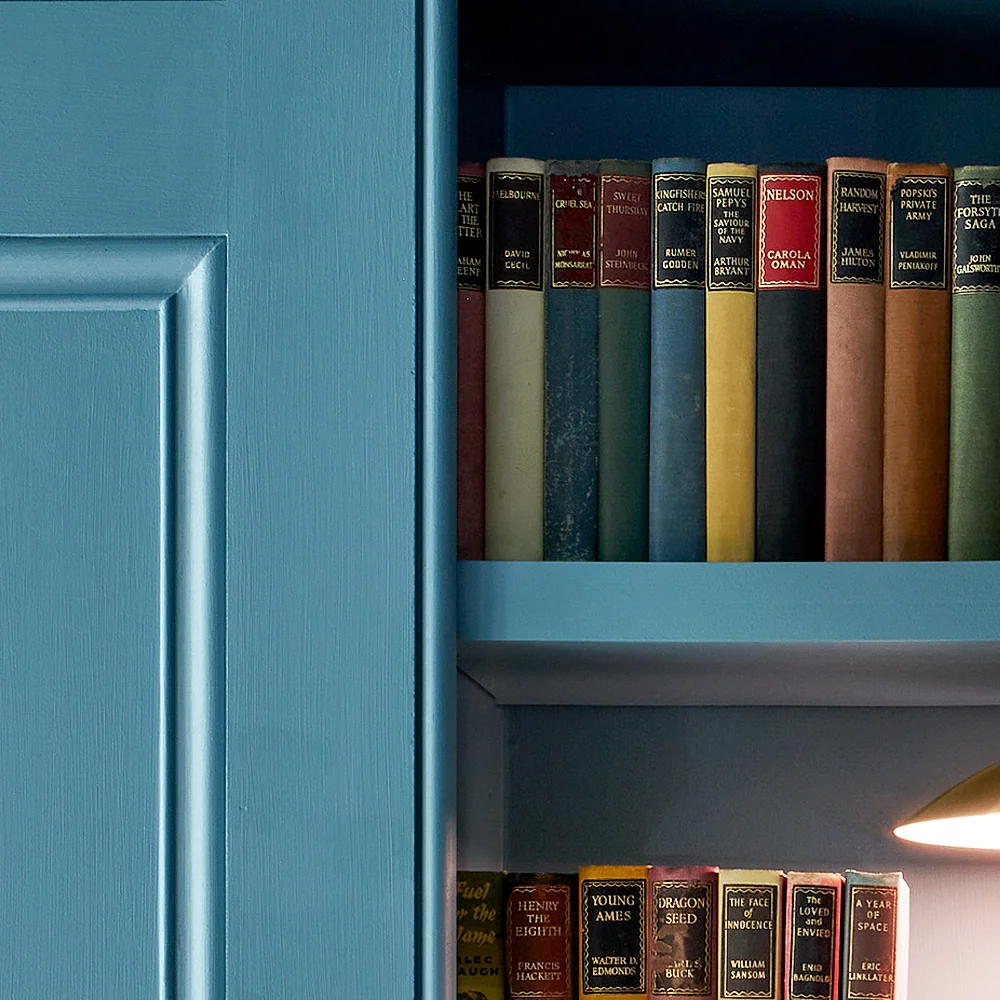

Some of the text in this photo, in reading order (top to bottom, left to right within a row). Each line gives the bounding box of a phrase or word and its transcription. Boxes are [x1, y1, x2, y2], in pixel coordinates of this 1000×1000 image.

[712, 188, 751, 198] SAMUEL
[767, 189, 814, 200] NELSON
[841, 188, 879, 199] RANDOM
[970, 195, 991, 204] THE
[900, 200, 936, 210] PRIVATE
[906, 212, 932, 221] ARMY
[714, 219, 749, 227] SAVIOUR
[965, 220, 996, 229] SAGA
[719, 236, 743, 244] NAVY
[616, 250, 637, 258] JOHN
[665, 249, 696, 257] RUMER
[767, 251, 811, 260] CAROLA
[842, 248, 874, 258] JAMES
[714, 258, 749, 266] ARTHUR
[842, 257, 875, 267] HILTON
[969, 255, 992, 264] JOHN
[771, 260, 805, 269] OMAN
[714, 267, 749, 276] BRYANT
[592, 895, 635, 907] YOUNG
[658, 898, 705, 909] DRAGON
[730, 898, 769, 907] THE FACE
[518, 901, 559, 912] HENRY
[596, 911, 631, 921] AMES
[800, 907, 830, 916] LOVED
[867, 911, 880, 919] OF
[666, 914, 697, 924] SEED
[857, 923, 888, 931] SPACE
[797, 928, 831, 938] ENVIED
[593, 967, 636, 976] EDMONDS
[731, 971, 765, 979] SANSOM
[849, 973, 893, 982] LINKLATER
